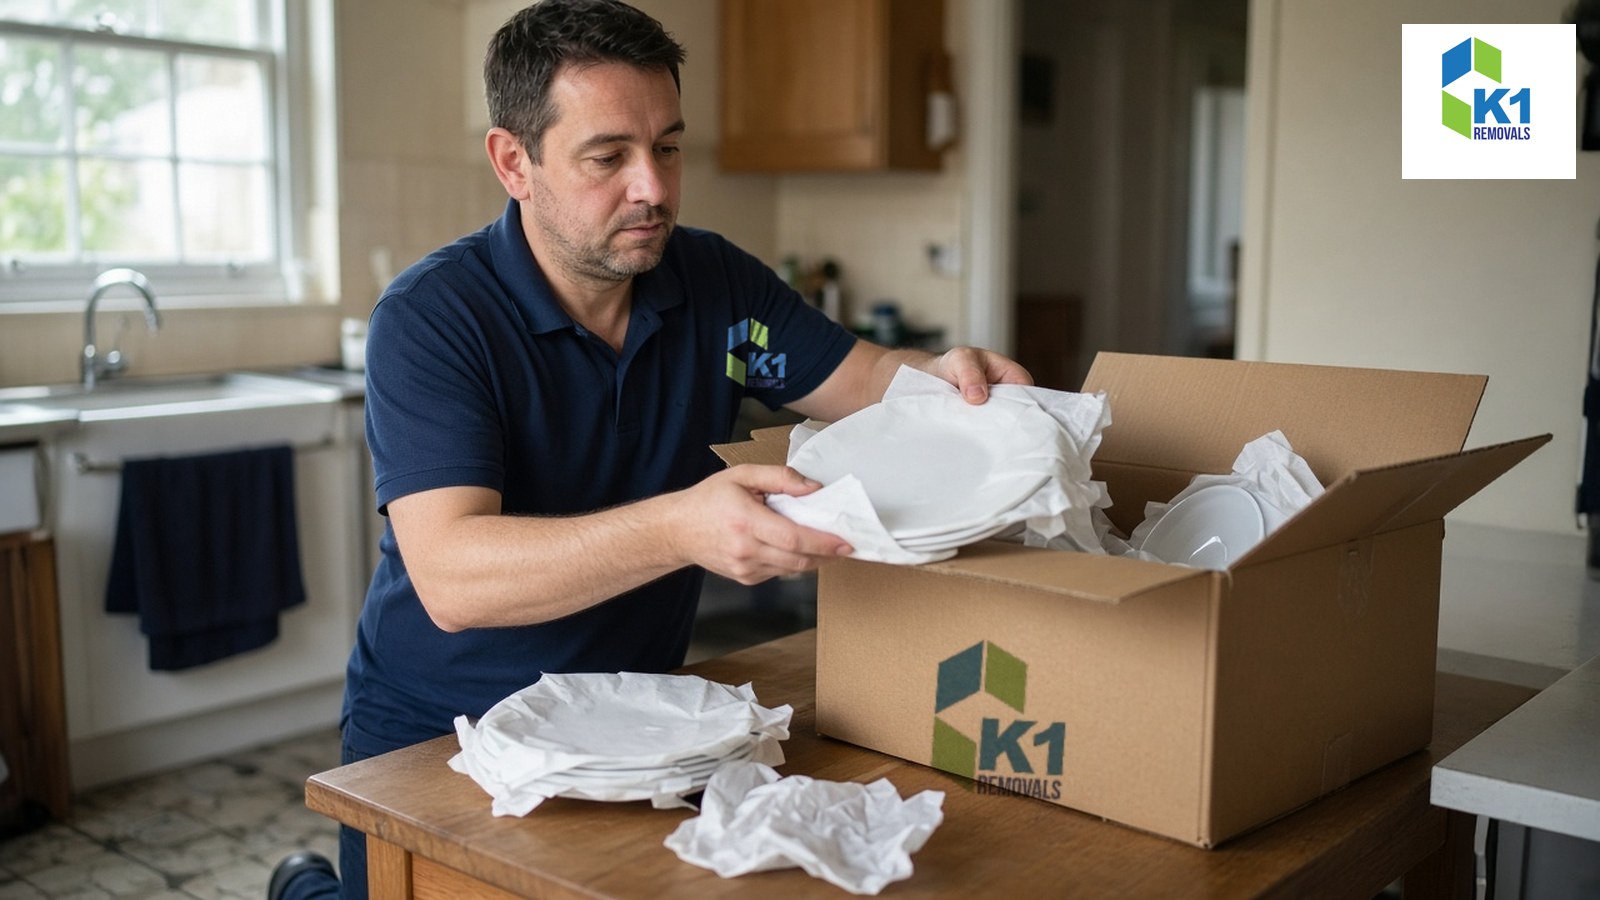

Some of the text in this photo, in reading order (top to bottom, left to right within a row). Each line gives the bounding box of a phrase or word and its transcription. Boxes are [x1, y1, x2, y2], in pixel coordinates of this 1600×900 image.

[748, 352, 786, 378] K1
[978, 717, 1066, 775] K1
[977, 775, 1062, 800] REMOVALS
